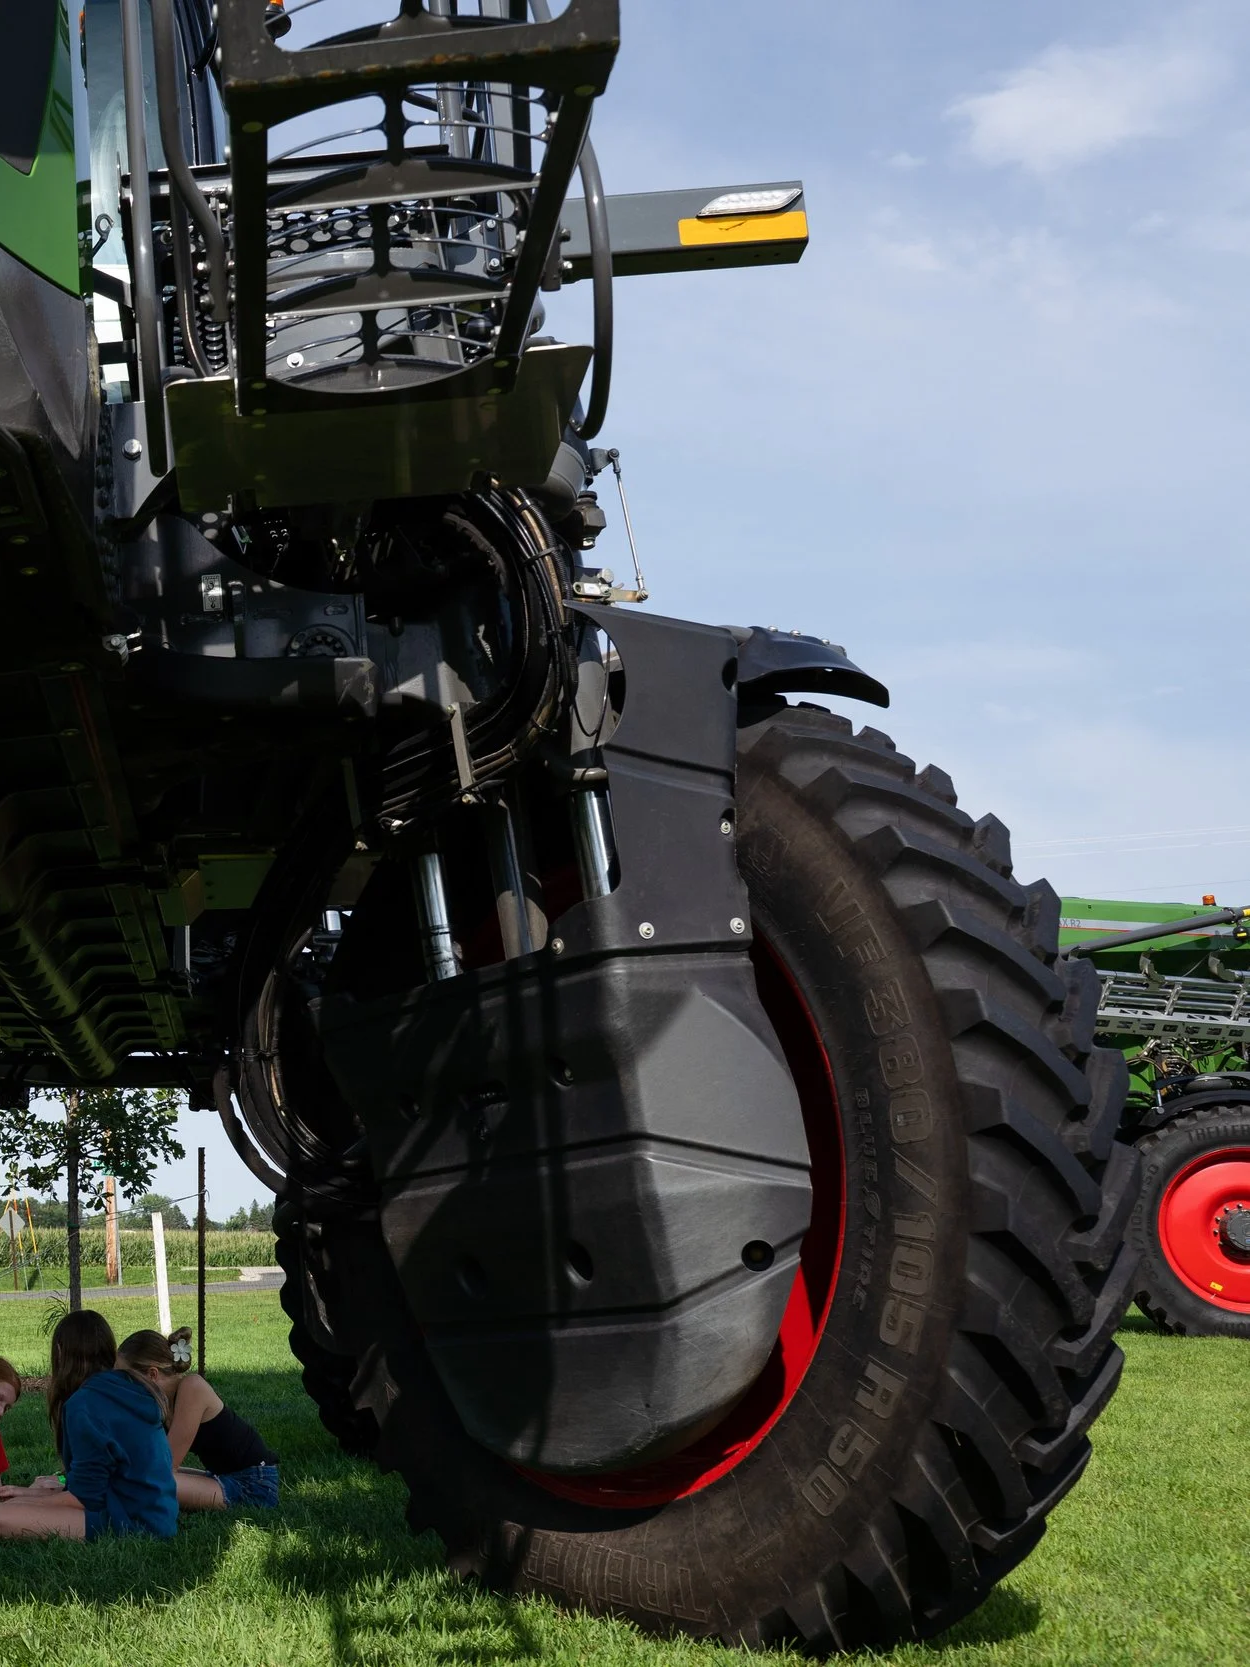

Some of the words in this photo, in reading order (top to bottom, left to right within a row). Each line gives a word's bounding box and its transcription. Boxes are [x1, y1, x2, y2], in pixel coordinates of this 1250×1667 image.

[816, 876, 888, 965] VF
[864, 978, 938, 1356] 380/105
[853, 1354, 909, 1419] R
[800, 1417, 881, 1517] 50
